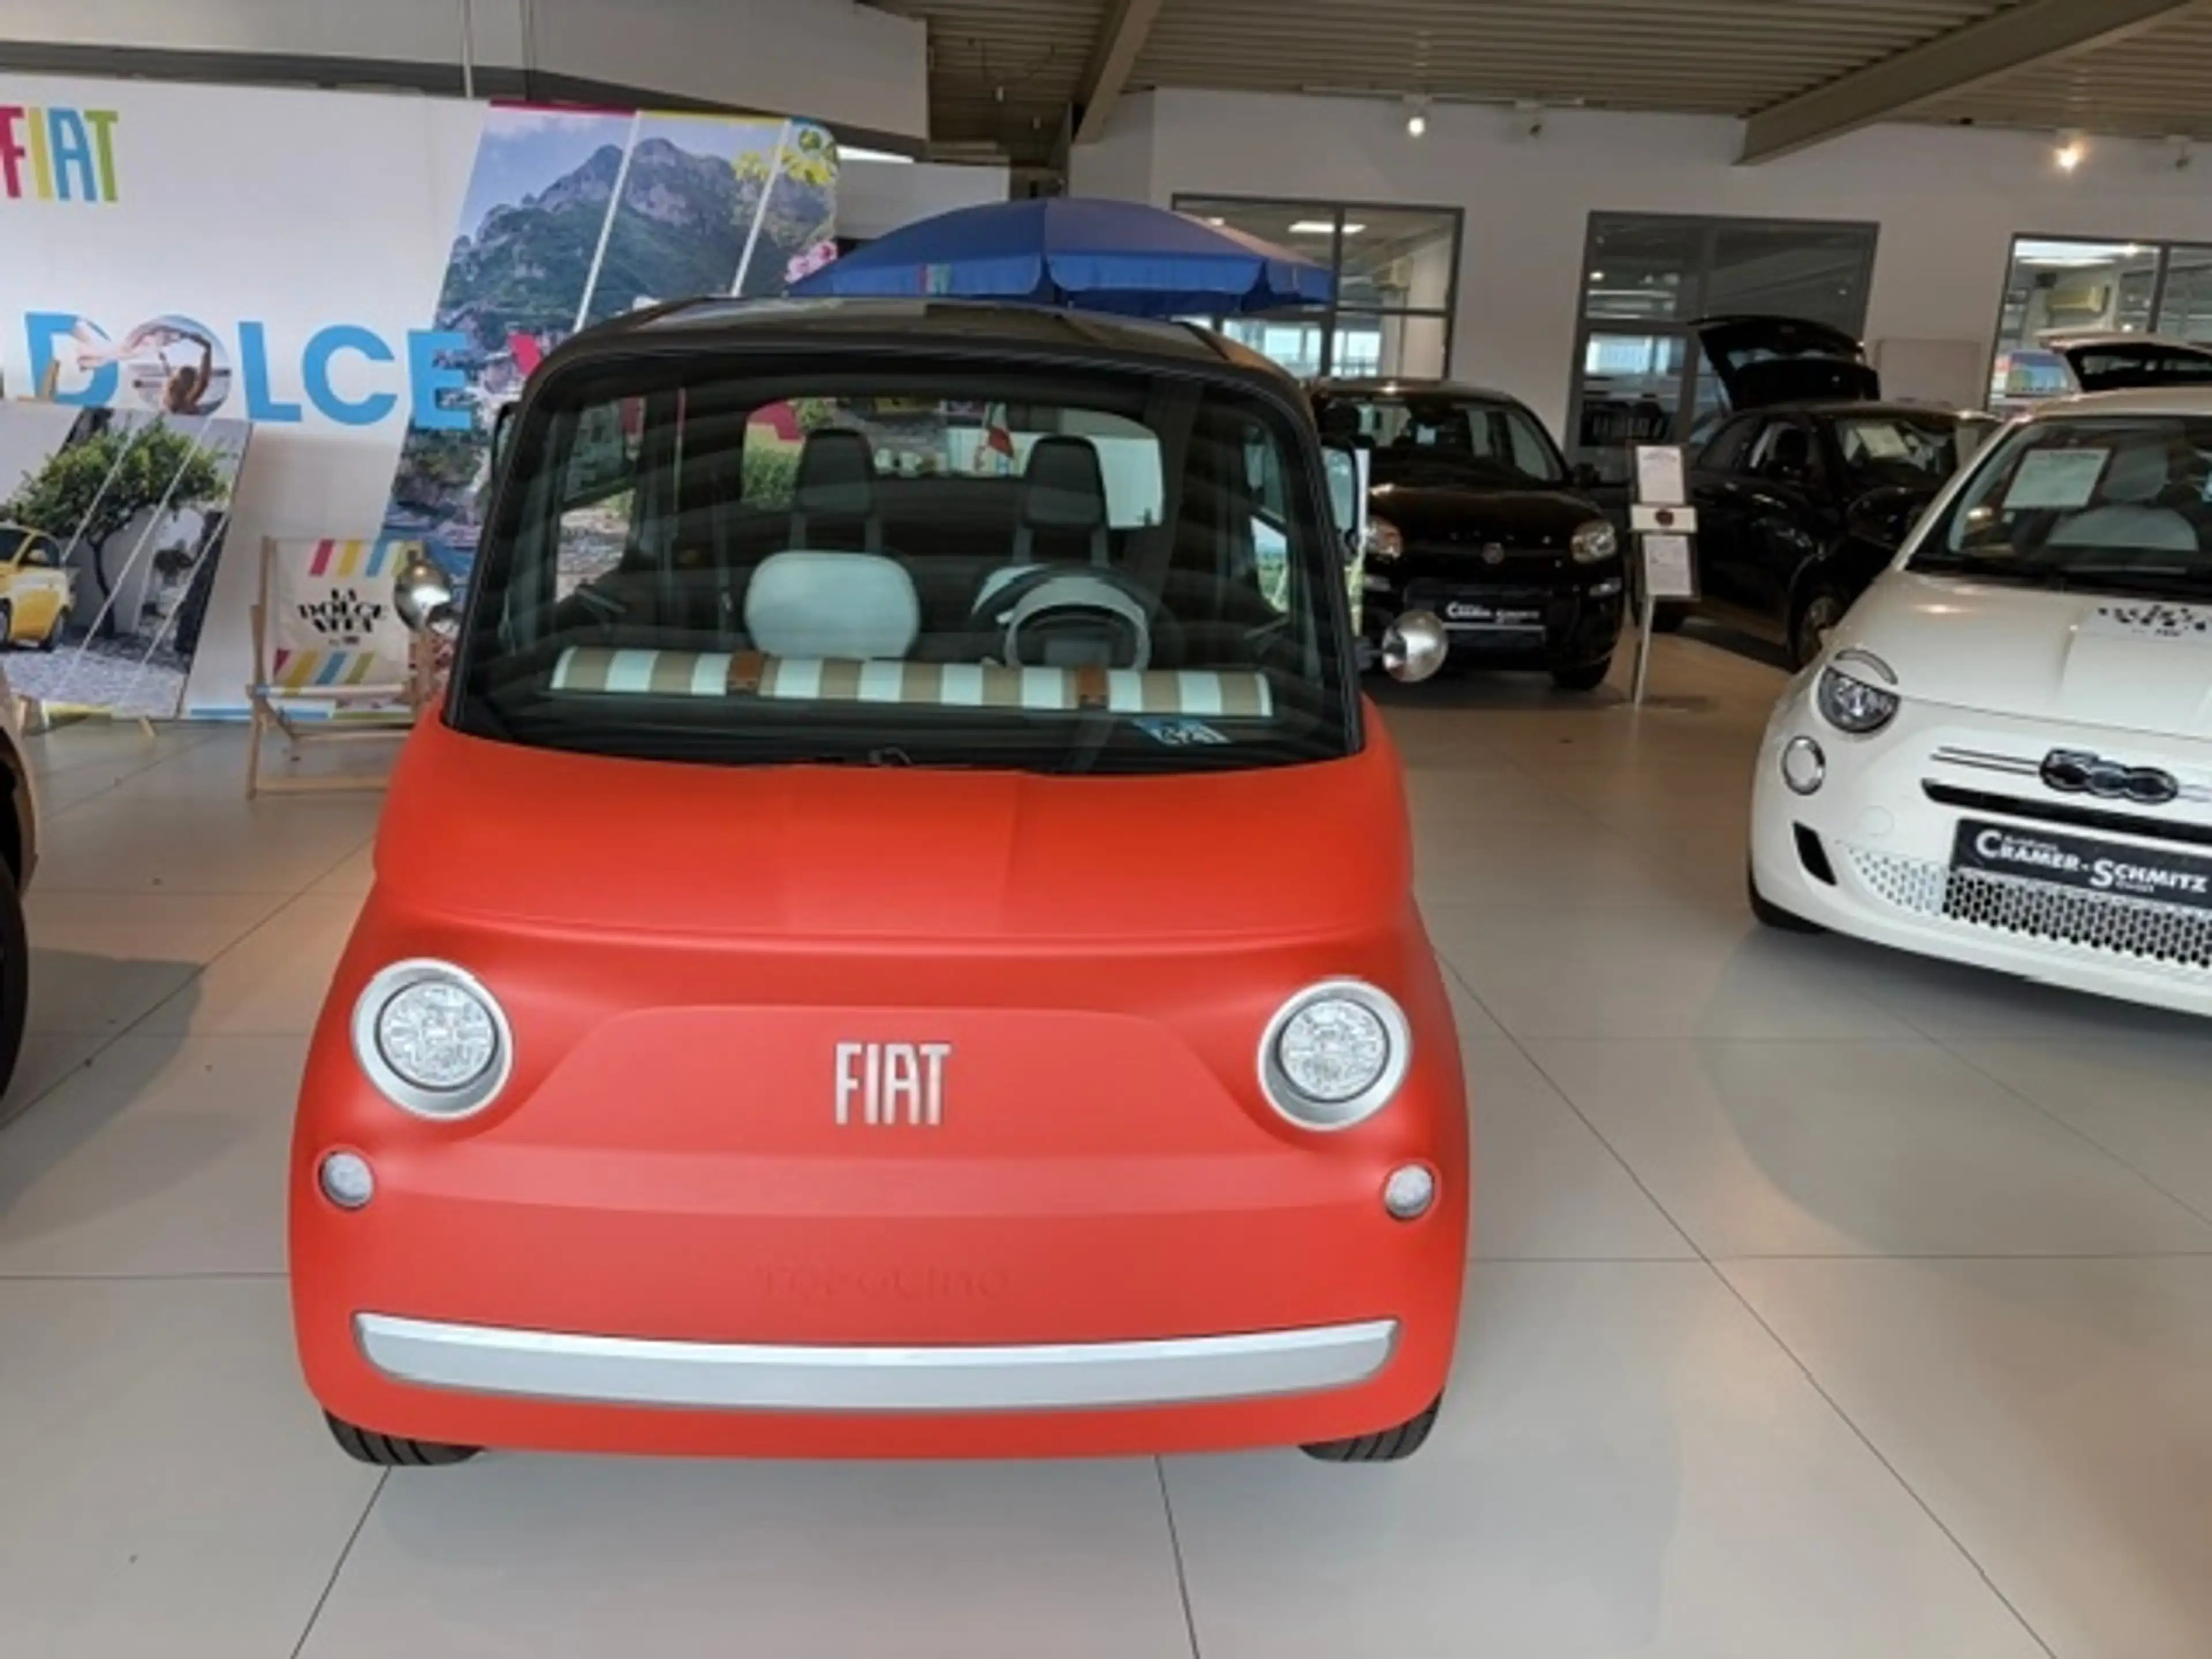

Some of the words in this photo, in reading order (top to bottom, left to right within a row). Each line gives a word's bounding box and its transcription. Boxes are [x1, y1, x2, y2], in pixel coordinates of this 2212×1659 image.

[0, 107, 119, 202] FIAT
[25, 312, 475, 431] DOLCE
[835, 1041, 952, 1126] FIAT
